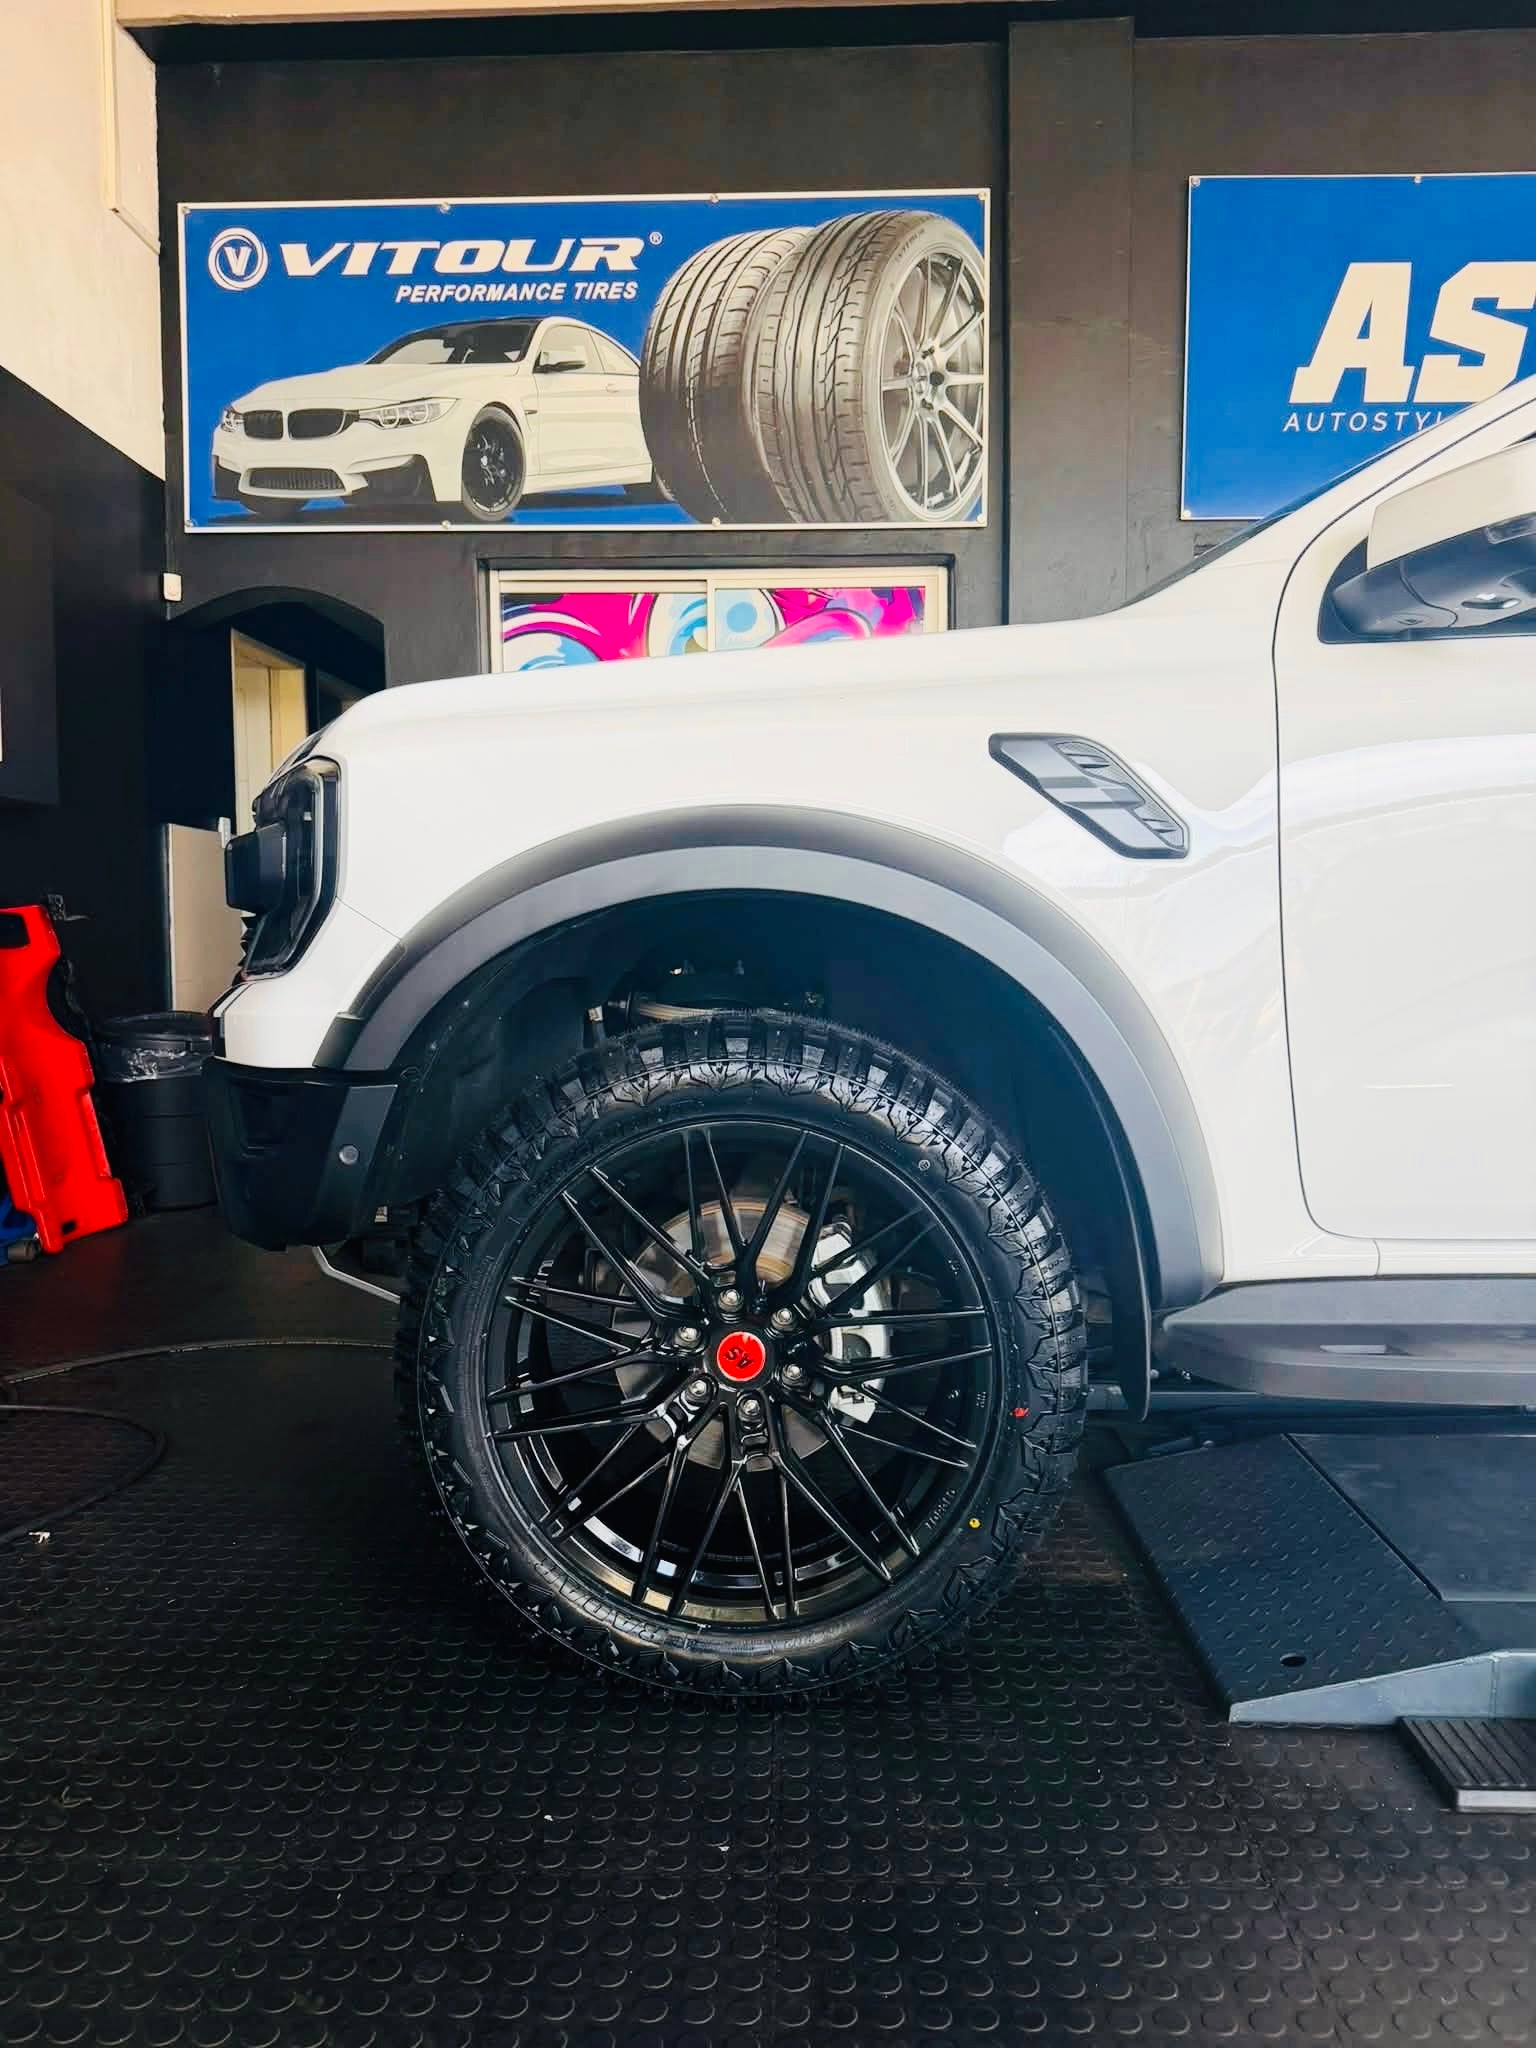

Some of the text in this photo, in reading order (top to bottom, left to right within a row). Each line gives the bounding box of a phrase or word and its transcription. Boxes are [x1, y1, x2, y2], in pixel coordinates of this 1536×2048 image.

[396, 281, 638, 303] PERFORMANCE TIRES
[1288, 261, 1536, 405] AS
